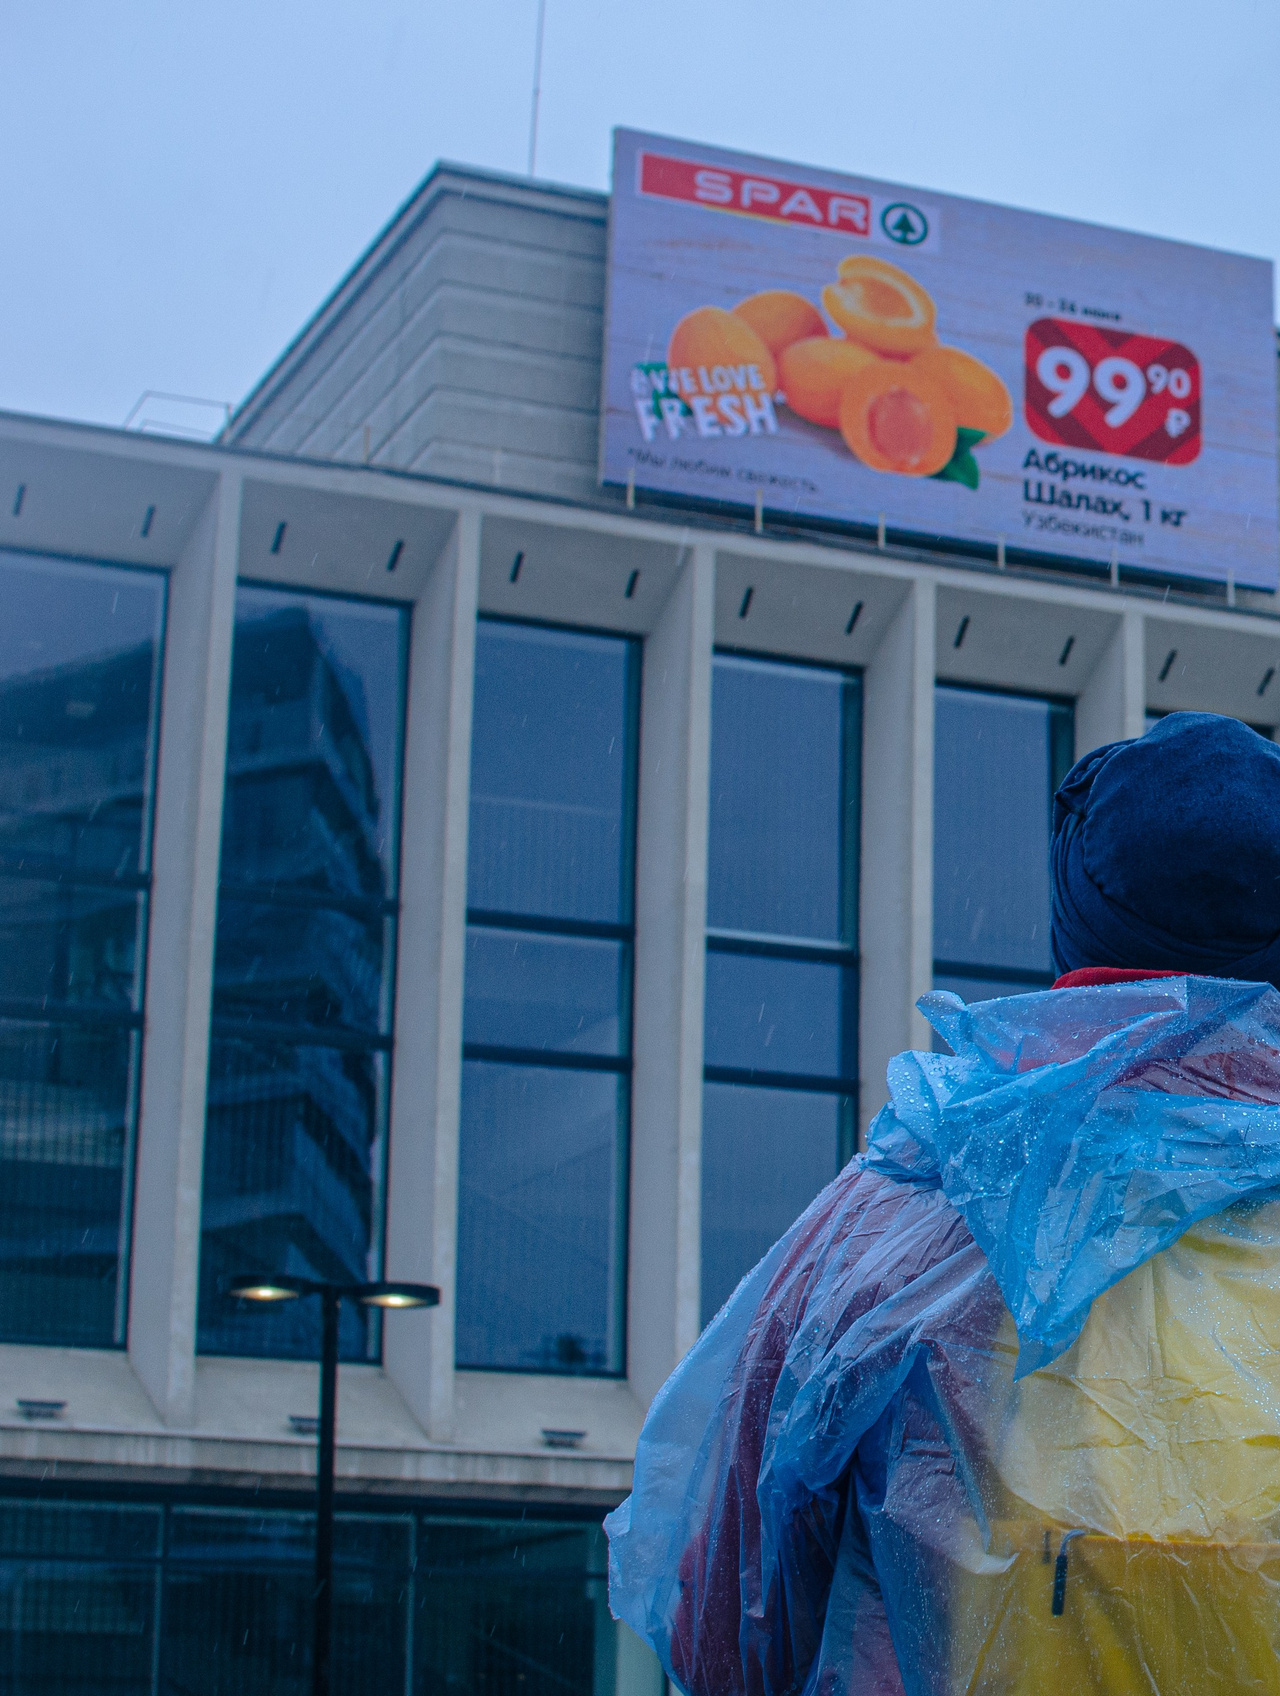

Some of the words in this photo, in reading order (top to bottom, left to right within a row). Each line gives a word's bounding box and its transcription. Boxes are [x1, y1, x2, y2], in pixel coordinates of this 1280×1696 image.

[694, 170, 868, 230] SPAR
[698, 364, 766, 394] LOVE
[1036, 345, 1147, 428] 99
[1147, 363, 1192, 399] 90
[1022, 448, 1147, 490] Абрикос
[1022, 479, 1131, 522] Шалах,
[1141, 498, 1152, 522] 1
[1160, 508, 1188, 528] кг
[1021, 509, 1146, 546] Узбекистан
